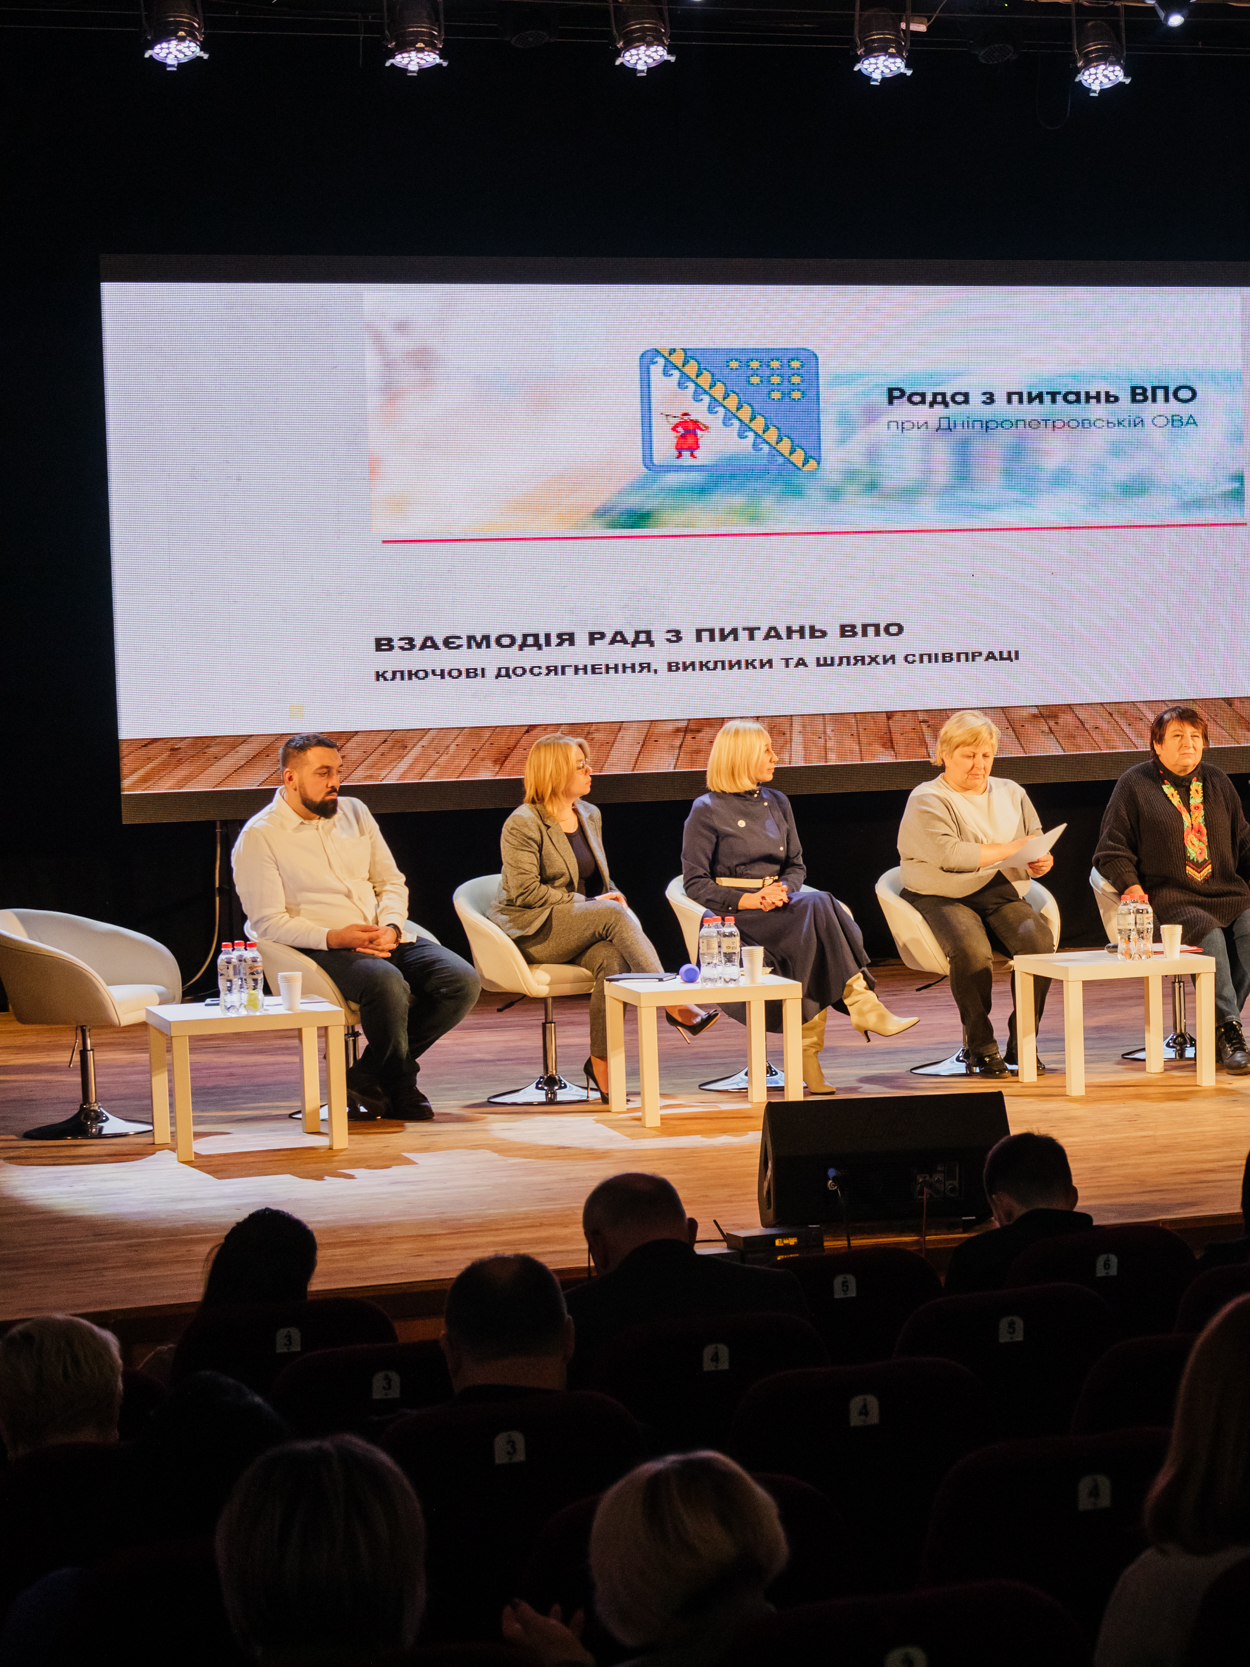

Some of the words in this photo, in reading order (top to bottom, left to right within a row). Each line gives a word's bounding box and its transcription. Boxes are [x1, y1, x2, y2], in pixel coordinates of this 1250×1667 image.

[887, 386, 971, 409] Рада
[981, 390, 995, 405] з
[1006, 390, 1120, 405] питань
[1130, 385, 1198, 404] ВПО
[886, 419, 929, 433] при
[936, 414, 1144, 433] Дніпропетровській
[1151, 414, 1199, 429] ОВА
[374, 632, 576, 652] ВЗАЄМОДІЯ
[588, 629, 656, 648] РАД
[695, 624, 828, 643] ПИТАНЬ
[839, 622, 905, 639] ВПО
[374, 667, 486, 682] КЛЮЧОВІ
[494, 662, 659, 680] ДОСЯГНЕННЯ,
[667, 658, 774, 673] ВИКЛИКИ
[780, 657, 809, 669] ТА
[815, 654, 897, 668] ШЛЯХИ
[903, 650, 1020, 666] СПІВПРАЦІ
